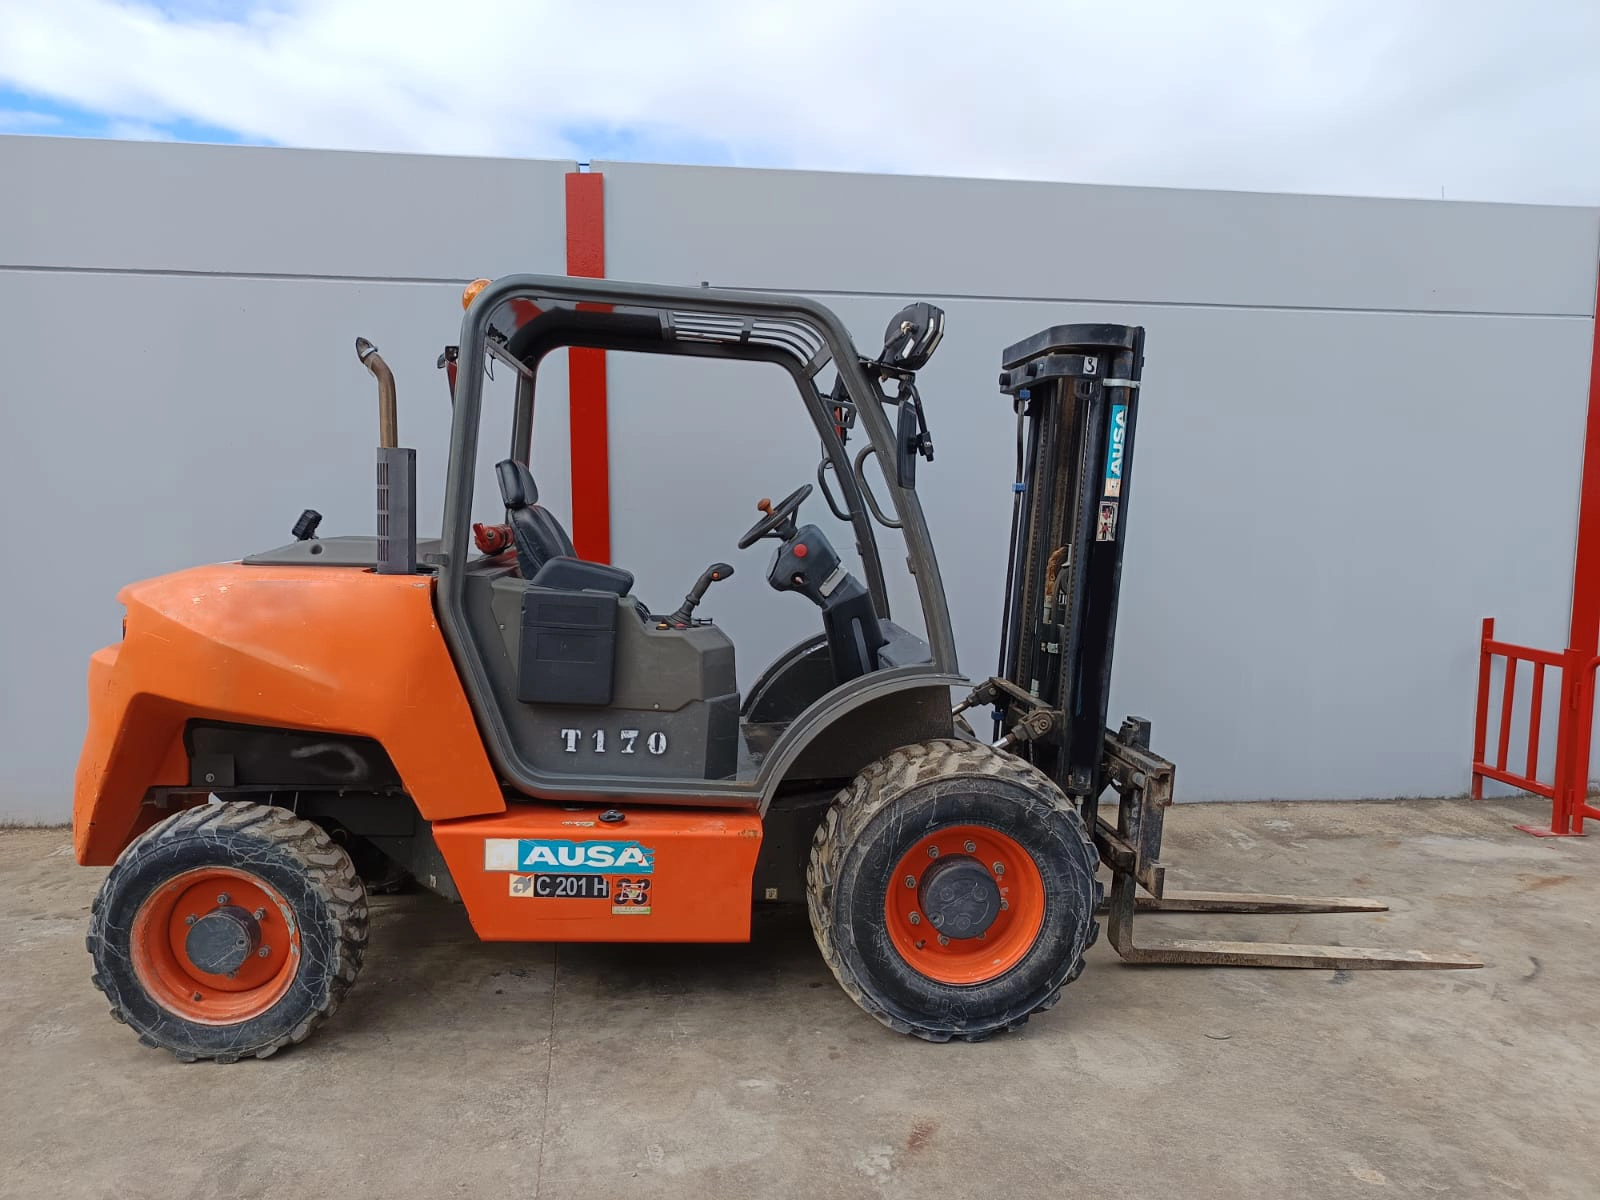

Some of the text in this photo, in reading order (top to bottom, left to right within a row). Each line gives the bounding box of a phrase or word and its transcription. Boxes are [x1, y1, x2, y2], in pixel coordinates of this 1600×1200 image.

[1110, 409, 1126, 477] AUSA
[561, 728, 667, 754] T170
[523, 845, 650, 868] AUSA
[536, 876, 607, 897] C 201 H
